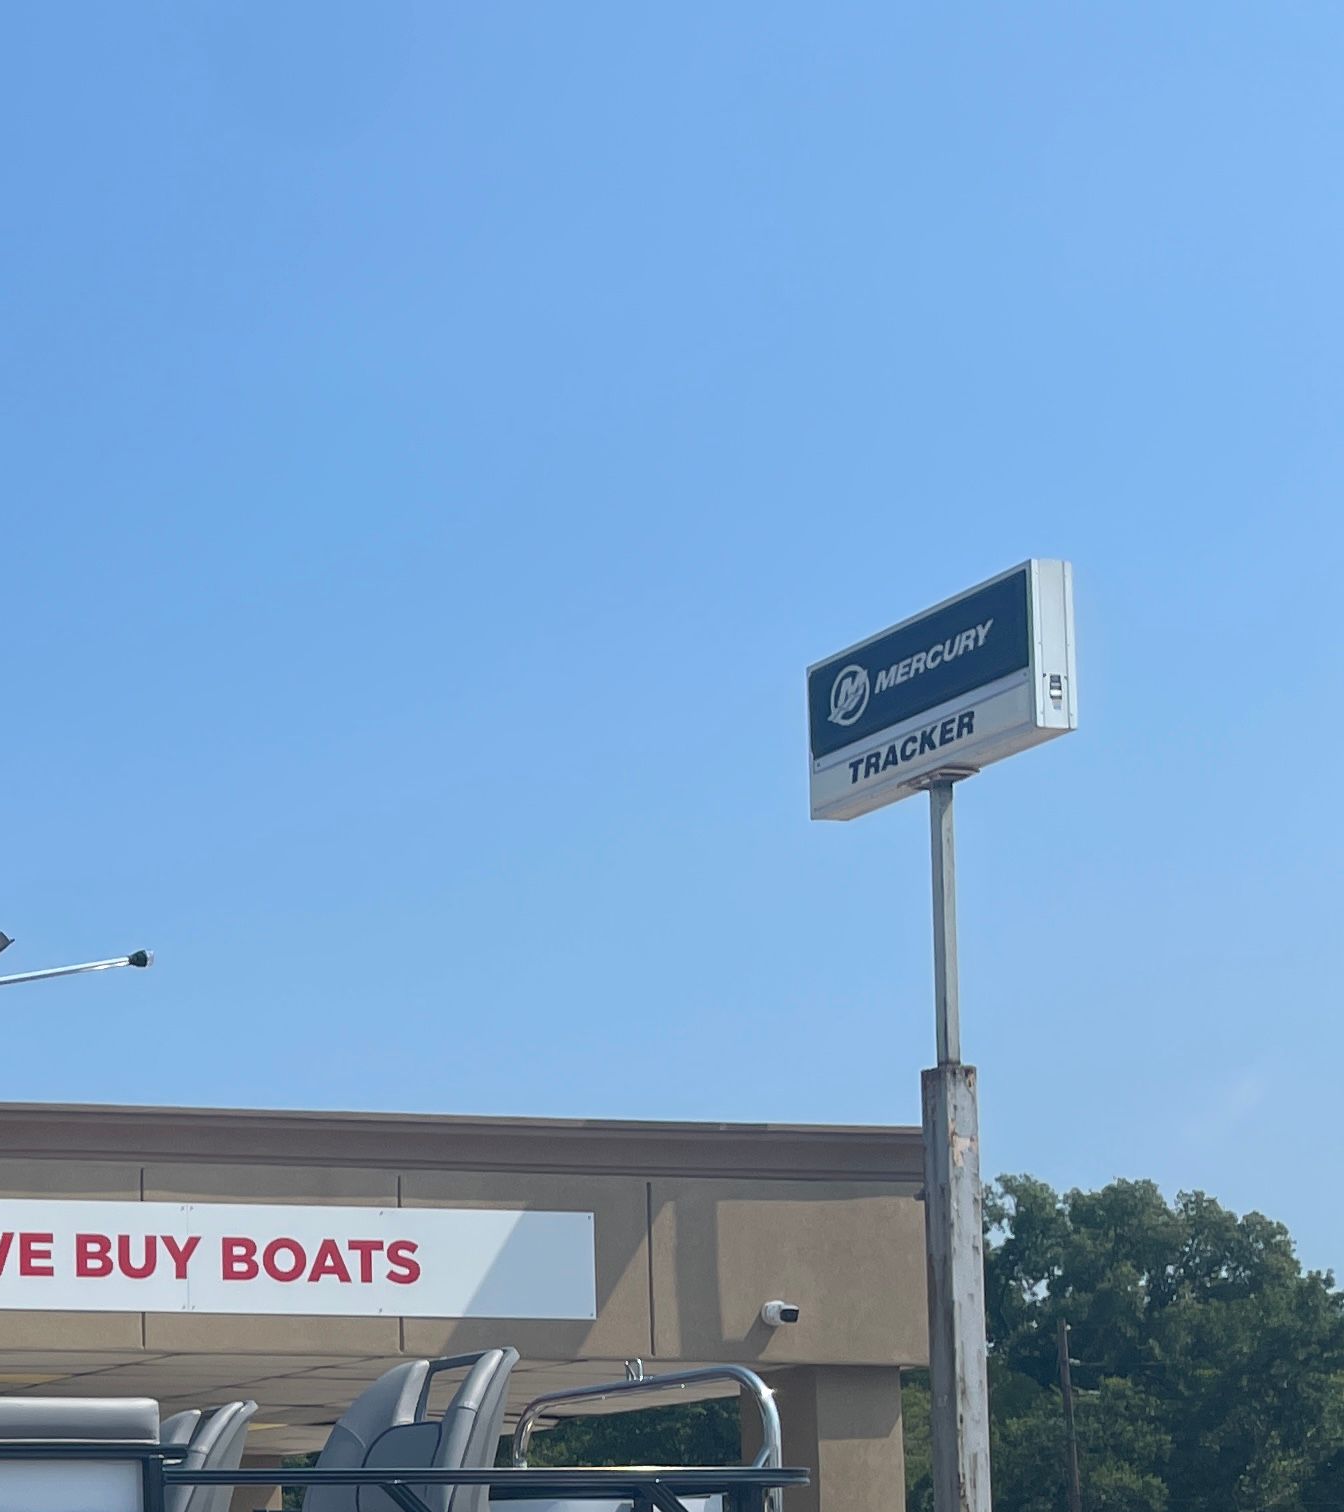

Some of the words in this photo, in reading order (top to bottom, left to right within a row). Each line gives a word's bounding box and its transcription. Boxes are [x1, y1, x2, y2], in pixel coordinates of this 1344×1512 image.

[874, 618, 994, 694] MERCURY
[849, 711, 975, 784] TRACKER
[75, 1233, 201, 1281] BUY
[221, 1237, 422, 1285] BOATS
